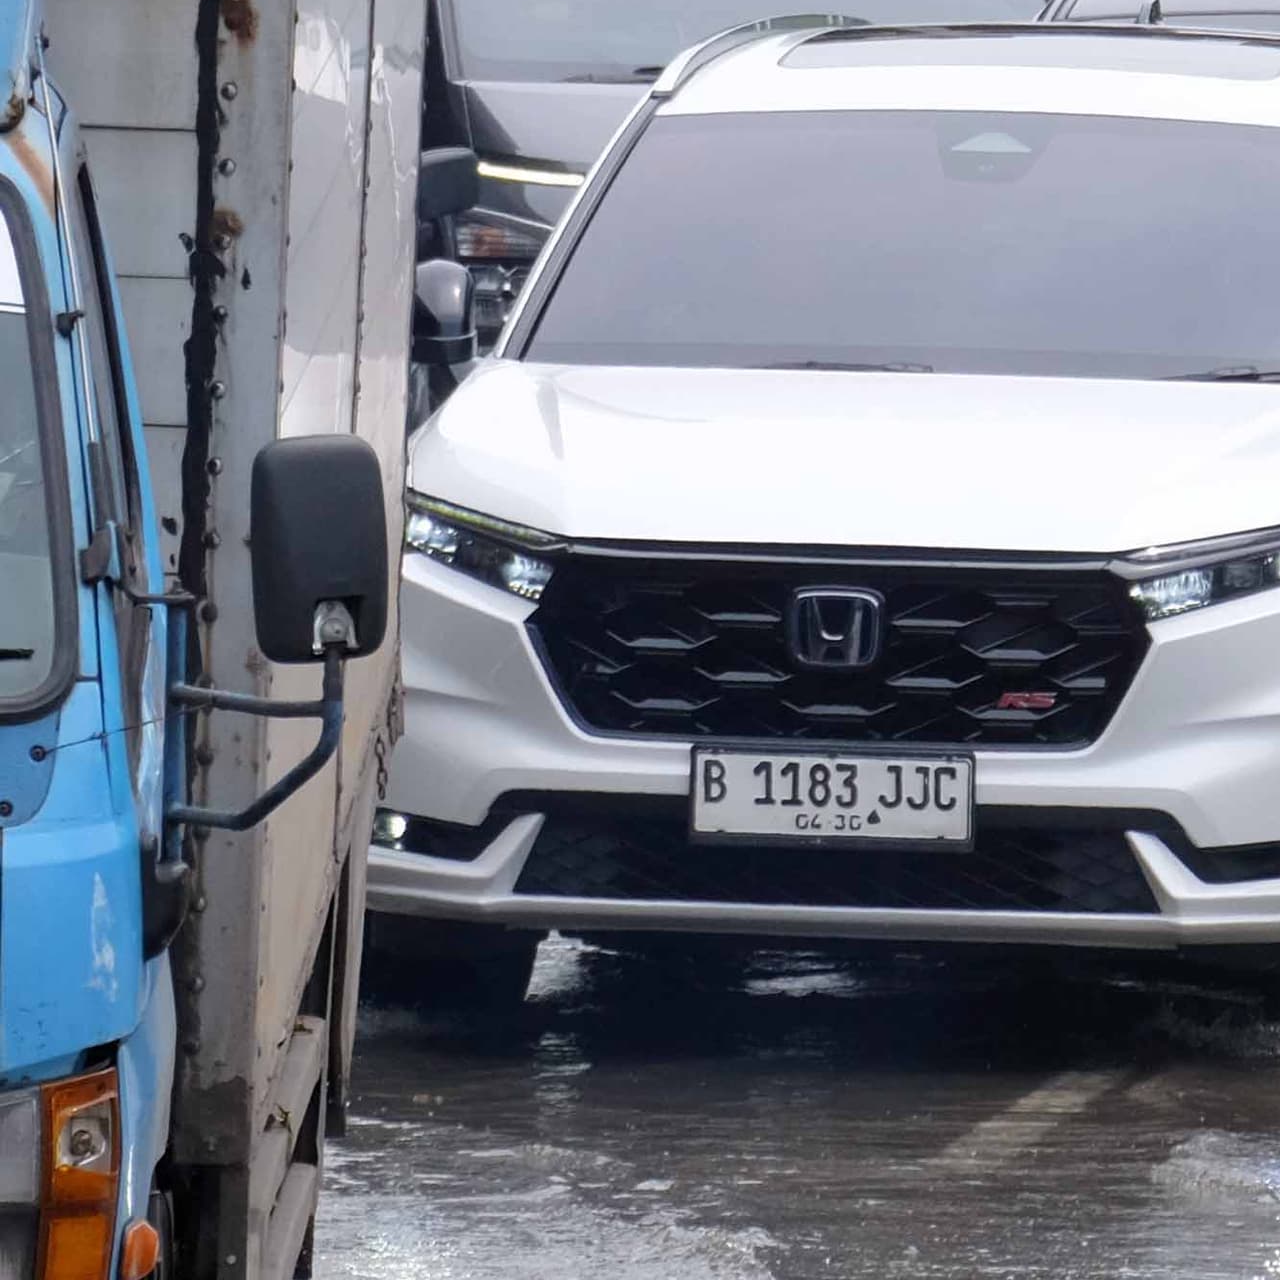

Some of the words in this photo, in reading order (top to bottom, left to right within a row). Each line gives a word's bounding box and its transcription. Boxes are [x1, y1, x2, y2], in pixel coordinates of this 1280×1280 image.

[998, 691, 1058, 708] RS
[704, 759, 727, 803] B
[753, 761, 859, 808] 1183
[878, 765, 957, 811] JJC
